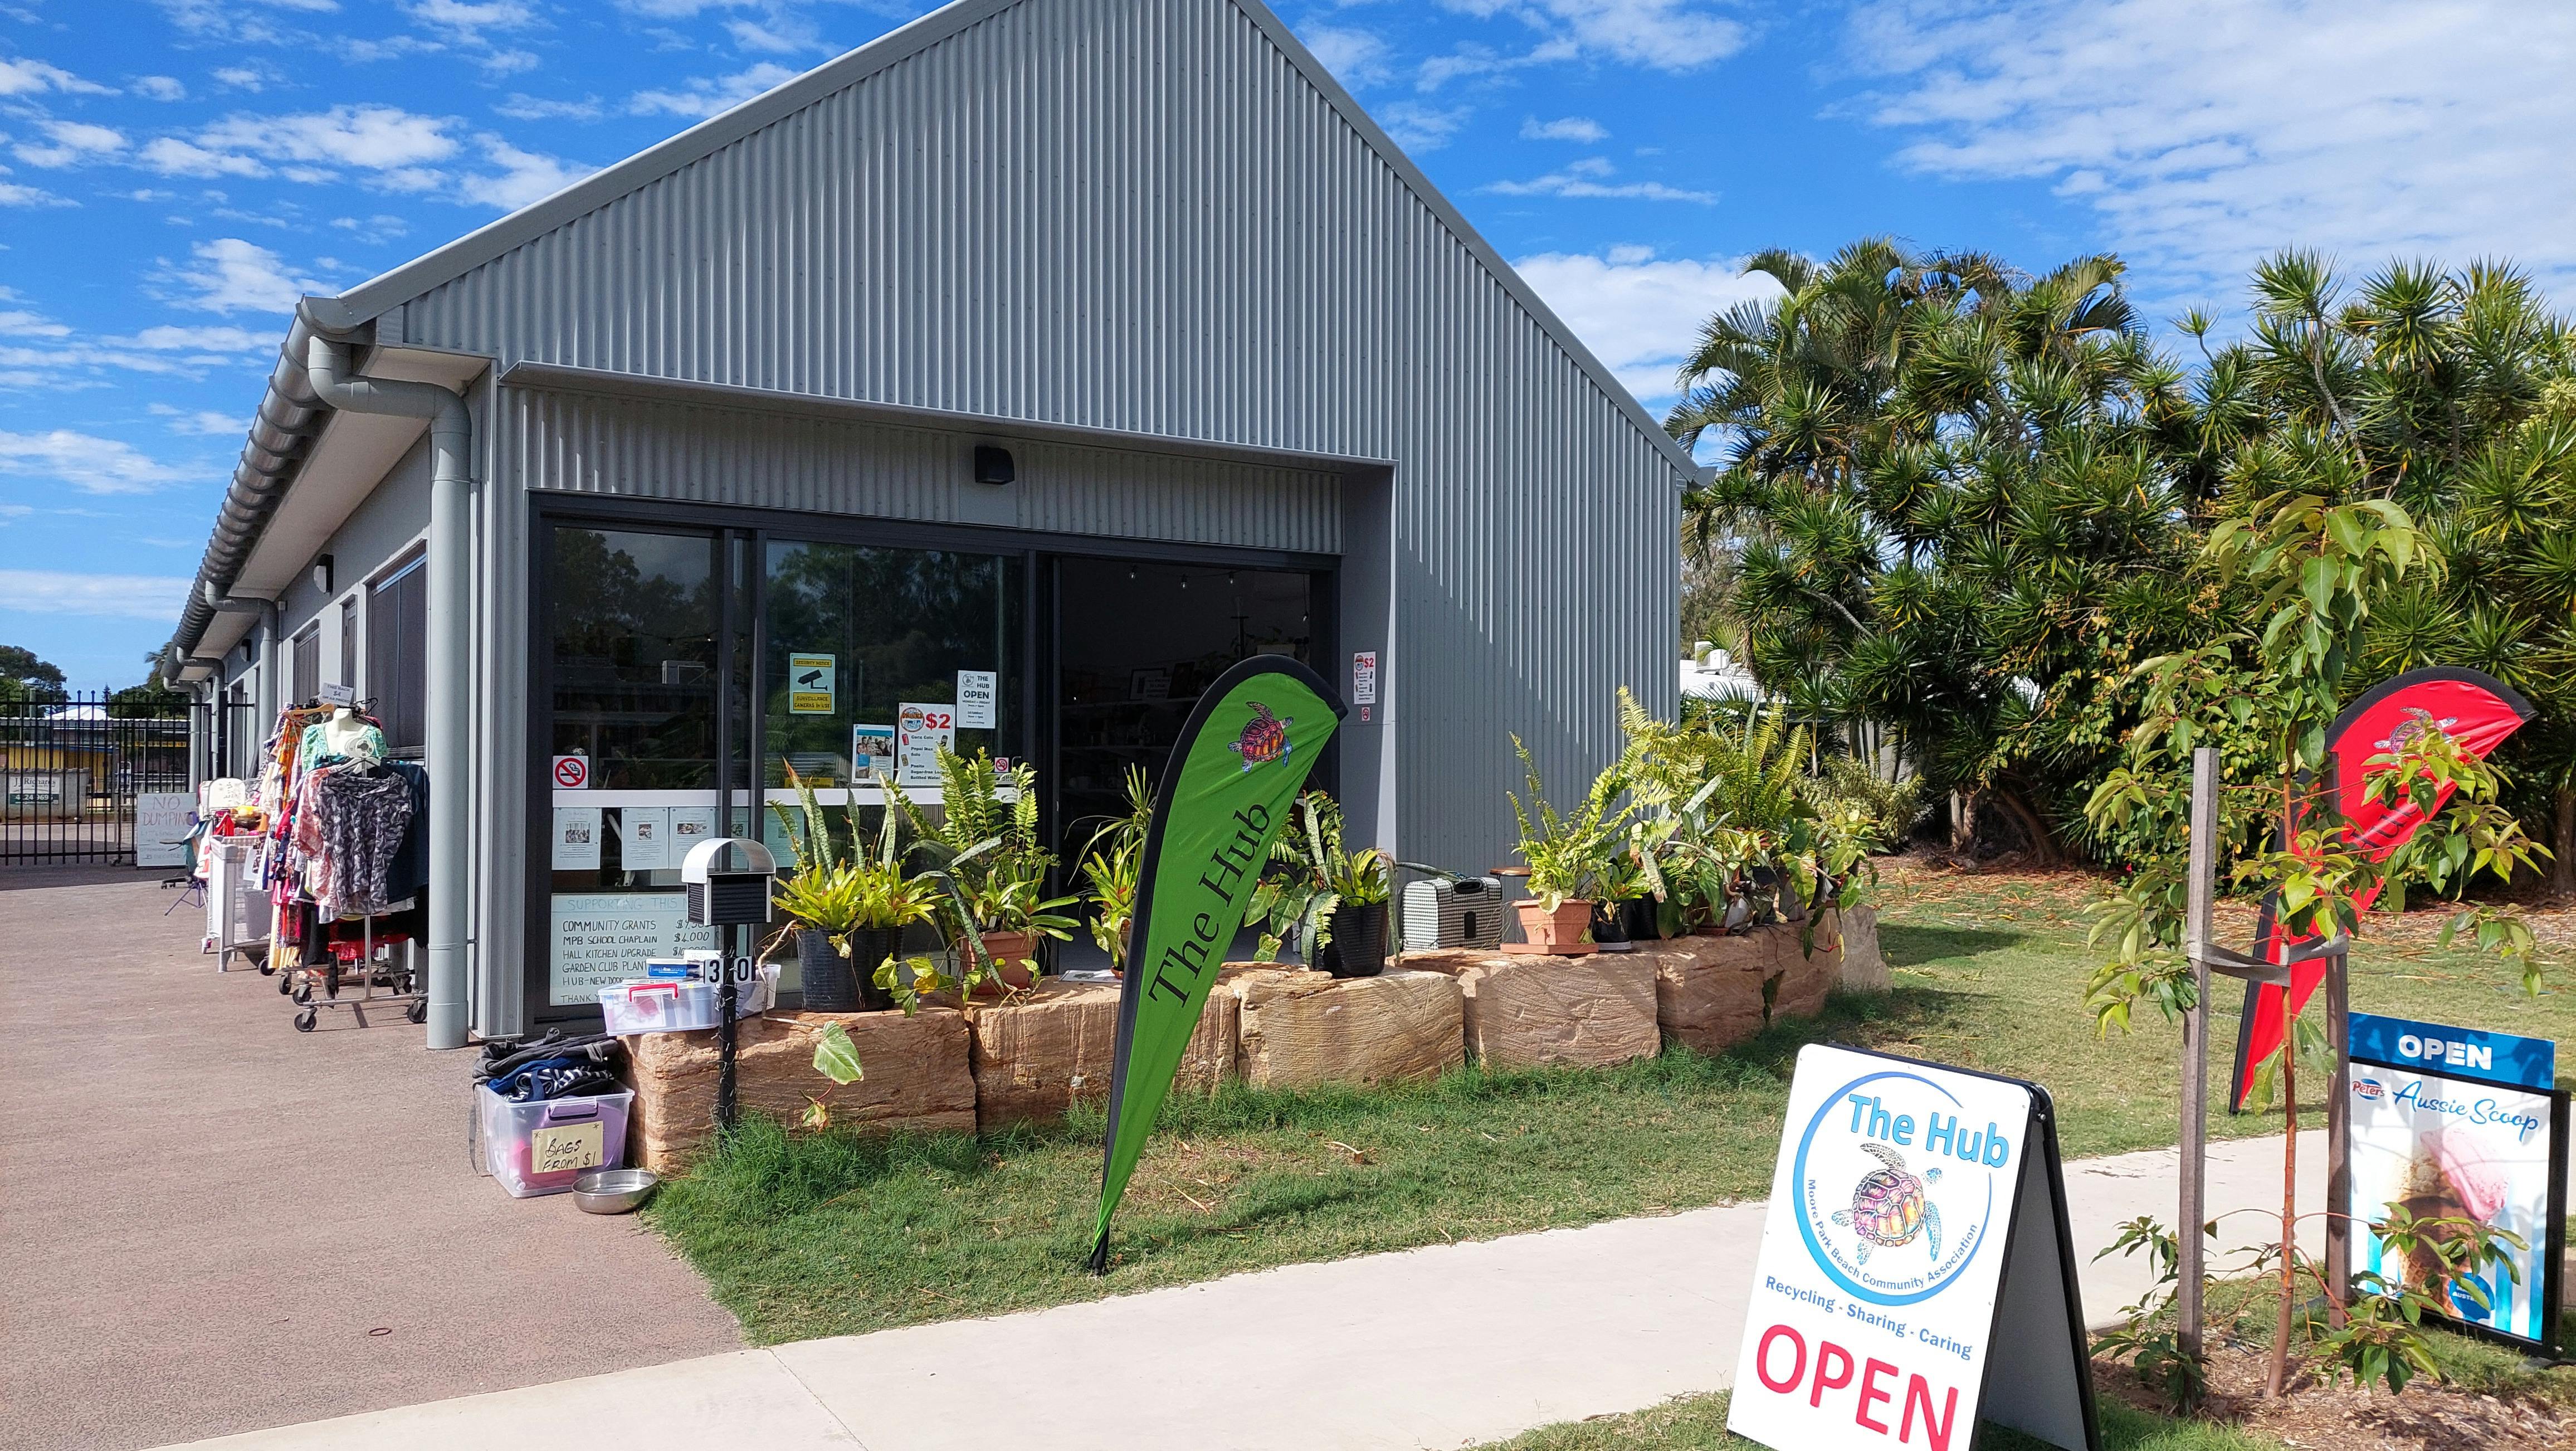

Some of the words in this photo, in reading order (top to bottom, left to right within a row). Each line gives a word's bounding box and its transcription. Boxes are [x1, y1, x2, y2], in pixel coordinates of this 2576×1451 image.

[963, 690, 989, 699] OPEN
[925, 712, 950, 731] $2
[153, 796, 180, 810] NO
[568, 897, 643, 910] SUPPORTING
[651, 898, 677, 909] THIS
[1148, 912, 1219, 1007] The
[1198, 803, 1270, 907] Hub
[563, 921, 619, 932] COMMUNITY
[622, 920, 656, 930] GRANTS
[563, 936, 583, 946] MPB
[563, 950, 582, 960] HALL
[586, 949, 617, 958] KITCHEN
[621, 948, 656, 957] UPGRADE
[562, 962, 596, 973] GARDEN
[598, 961, 618, 972] CLUB
[560, 994, 591, 1003] THANK
[2398, 1035, 2492, 1070] OPEN
[2352, 1080, 2385, 1097] Peters
[2393, 1080, 2468, 1112] Aussie
[2470, 1099, 2539, 1142] Scoop
[1849, 1093, 1915, 1146] The
[1926, 1112, 2009, 1168] Hub
[545, 1138, 582, 1157] BAGS
[542, 1156, 578, 1172] FROM
[583, 1151, 596, 1168] $1
[1808, 1179, 1818, 1219] Moore
[1815, 1221, 1832, 1249] Park
[1831, 1248, 1860, 1278] Beach
[1862, 1272, 1924, 1290] Community
[1928, 1224, 1978, 1283] Association
[1765, 1275, 1836, 1313] Recycling
[1847, 1303, 1907, 1338] Sharing
[1919, 1328, 1973, 1361] Caring
[1757, 1324, 1959, 1451] OPEN
